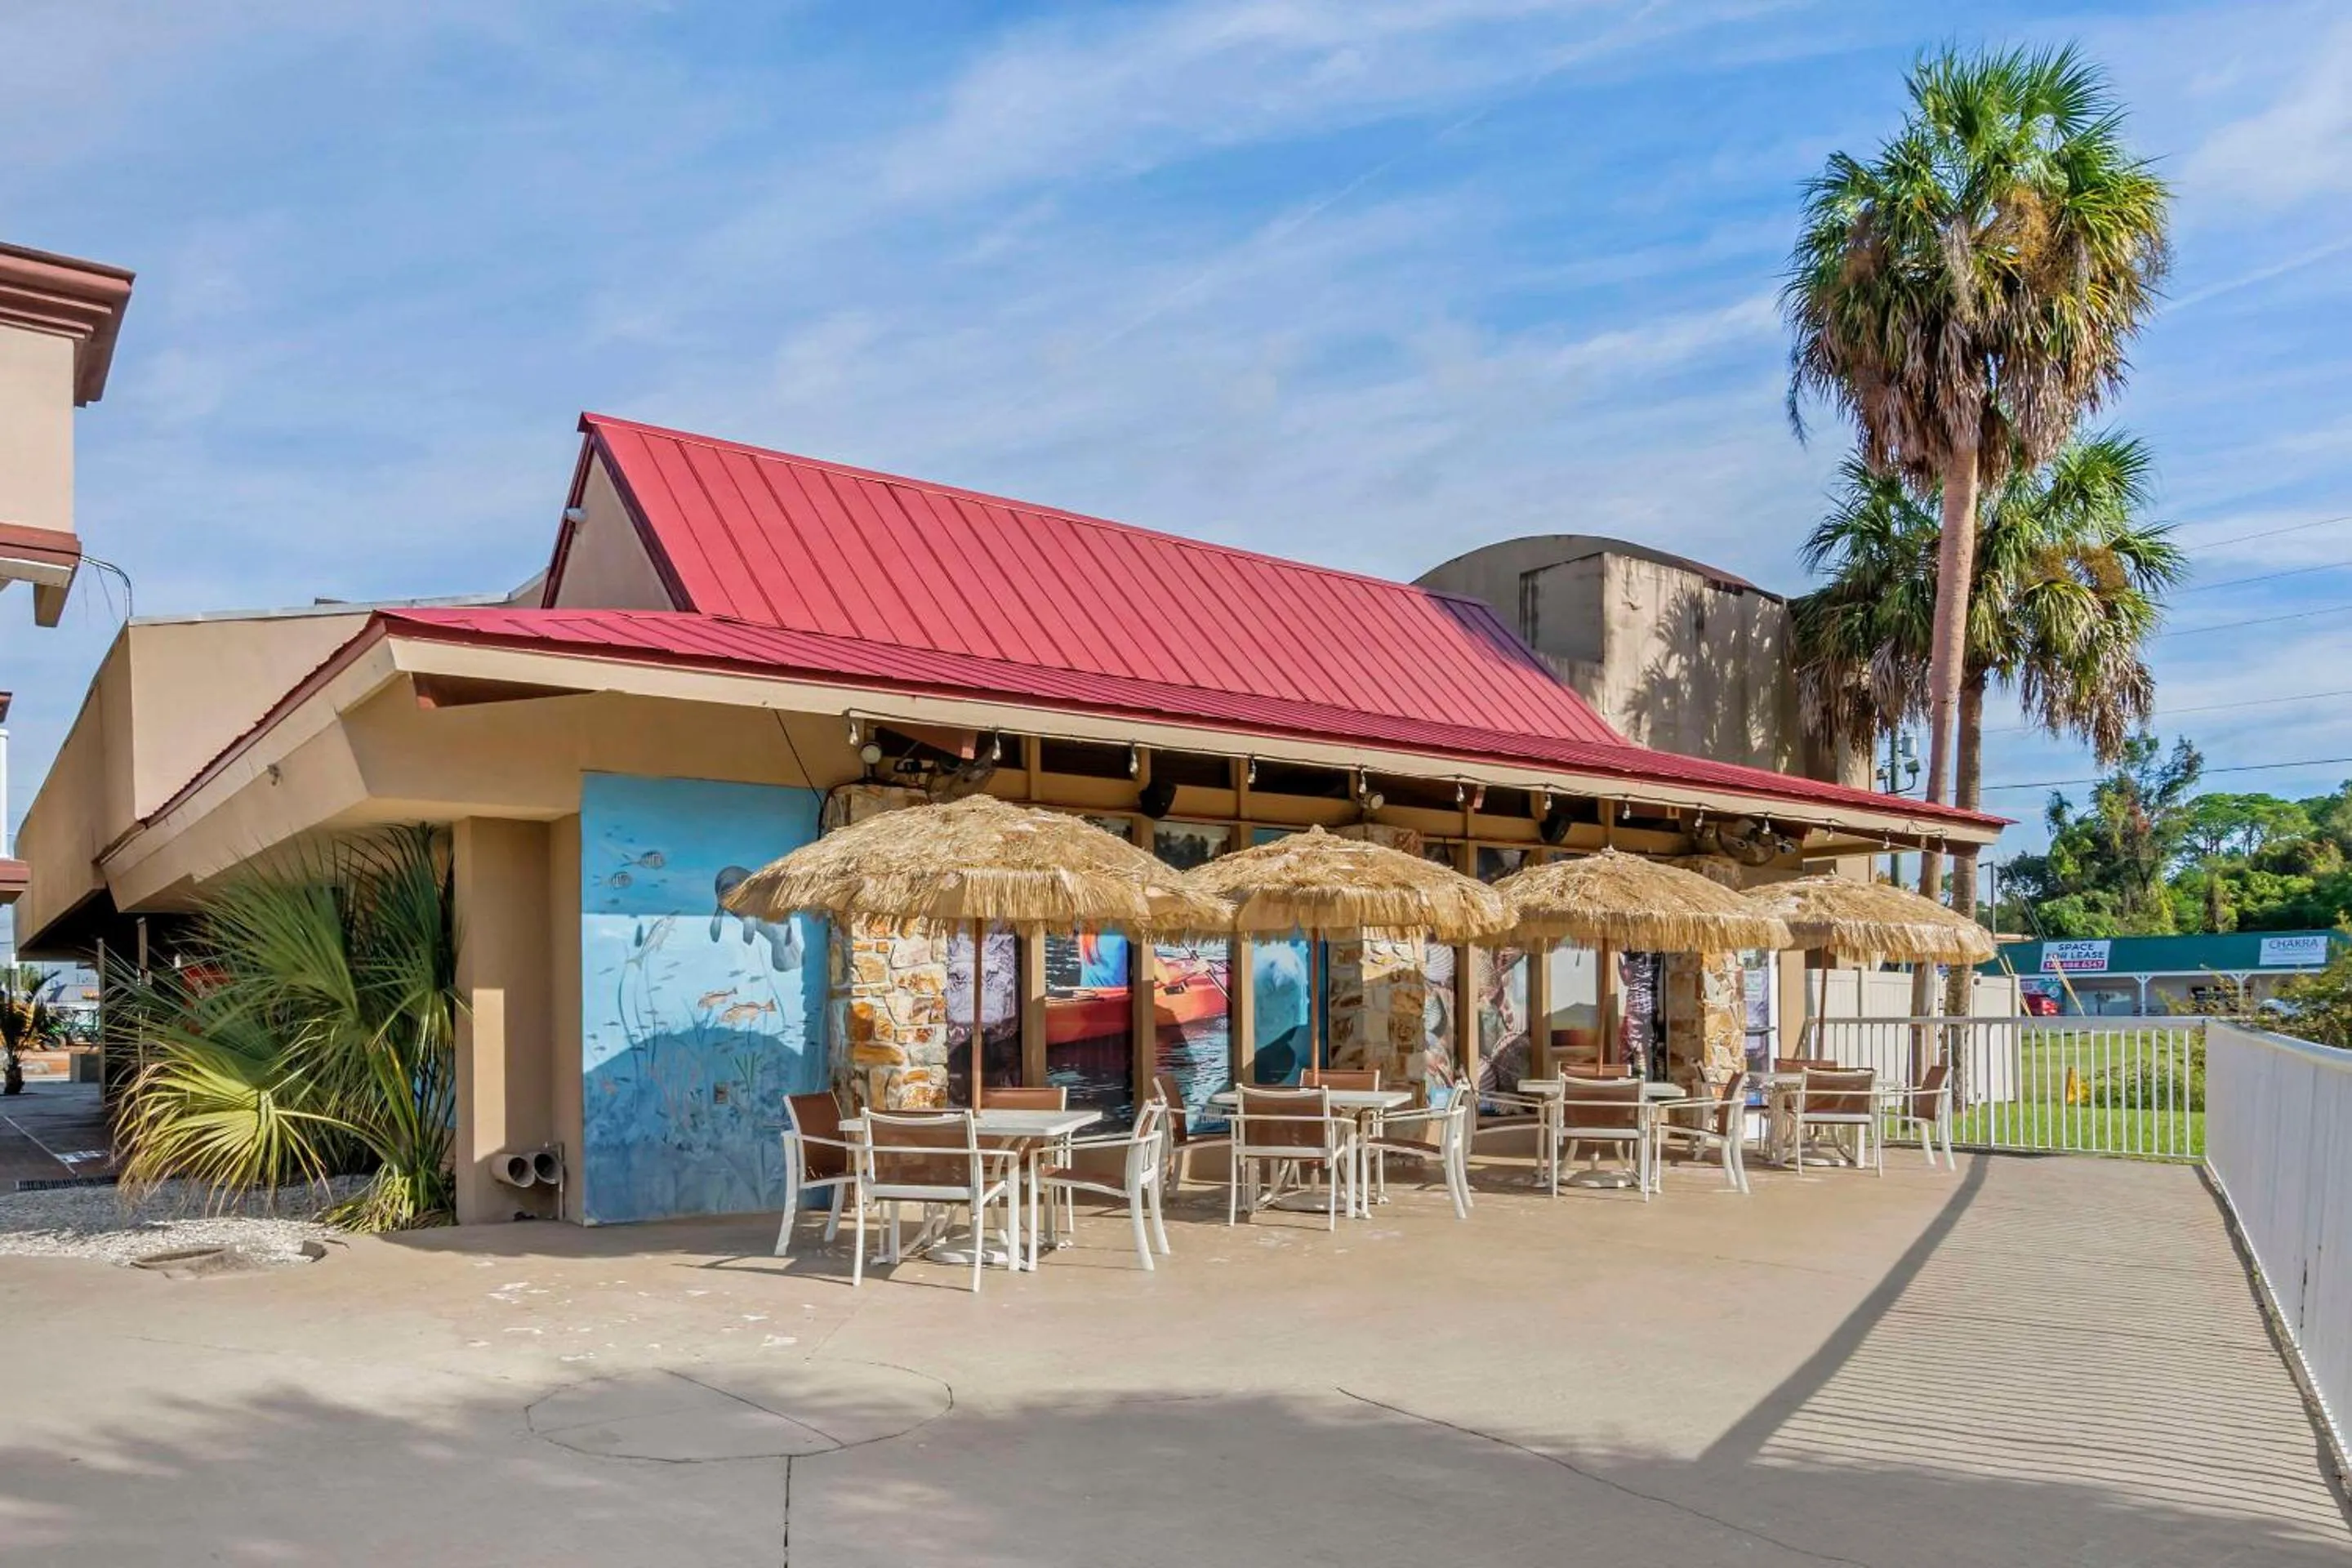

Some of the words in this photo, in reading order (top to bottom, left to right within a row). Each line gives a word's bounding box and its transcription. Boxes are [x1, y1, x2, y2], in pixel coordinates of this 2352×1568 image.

[2269, 938, 2319, 949] CHAKRA
[2046, 951, 2067, 960] FOR
[2070, 951, 2105, 959] LEASE
